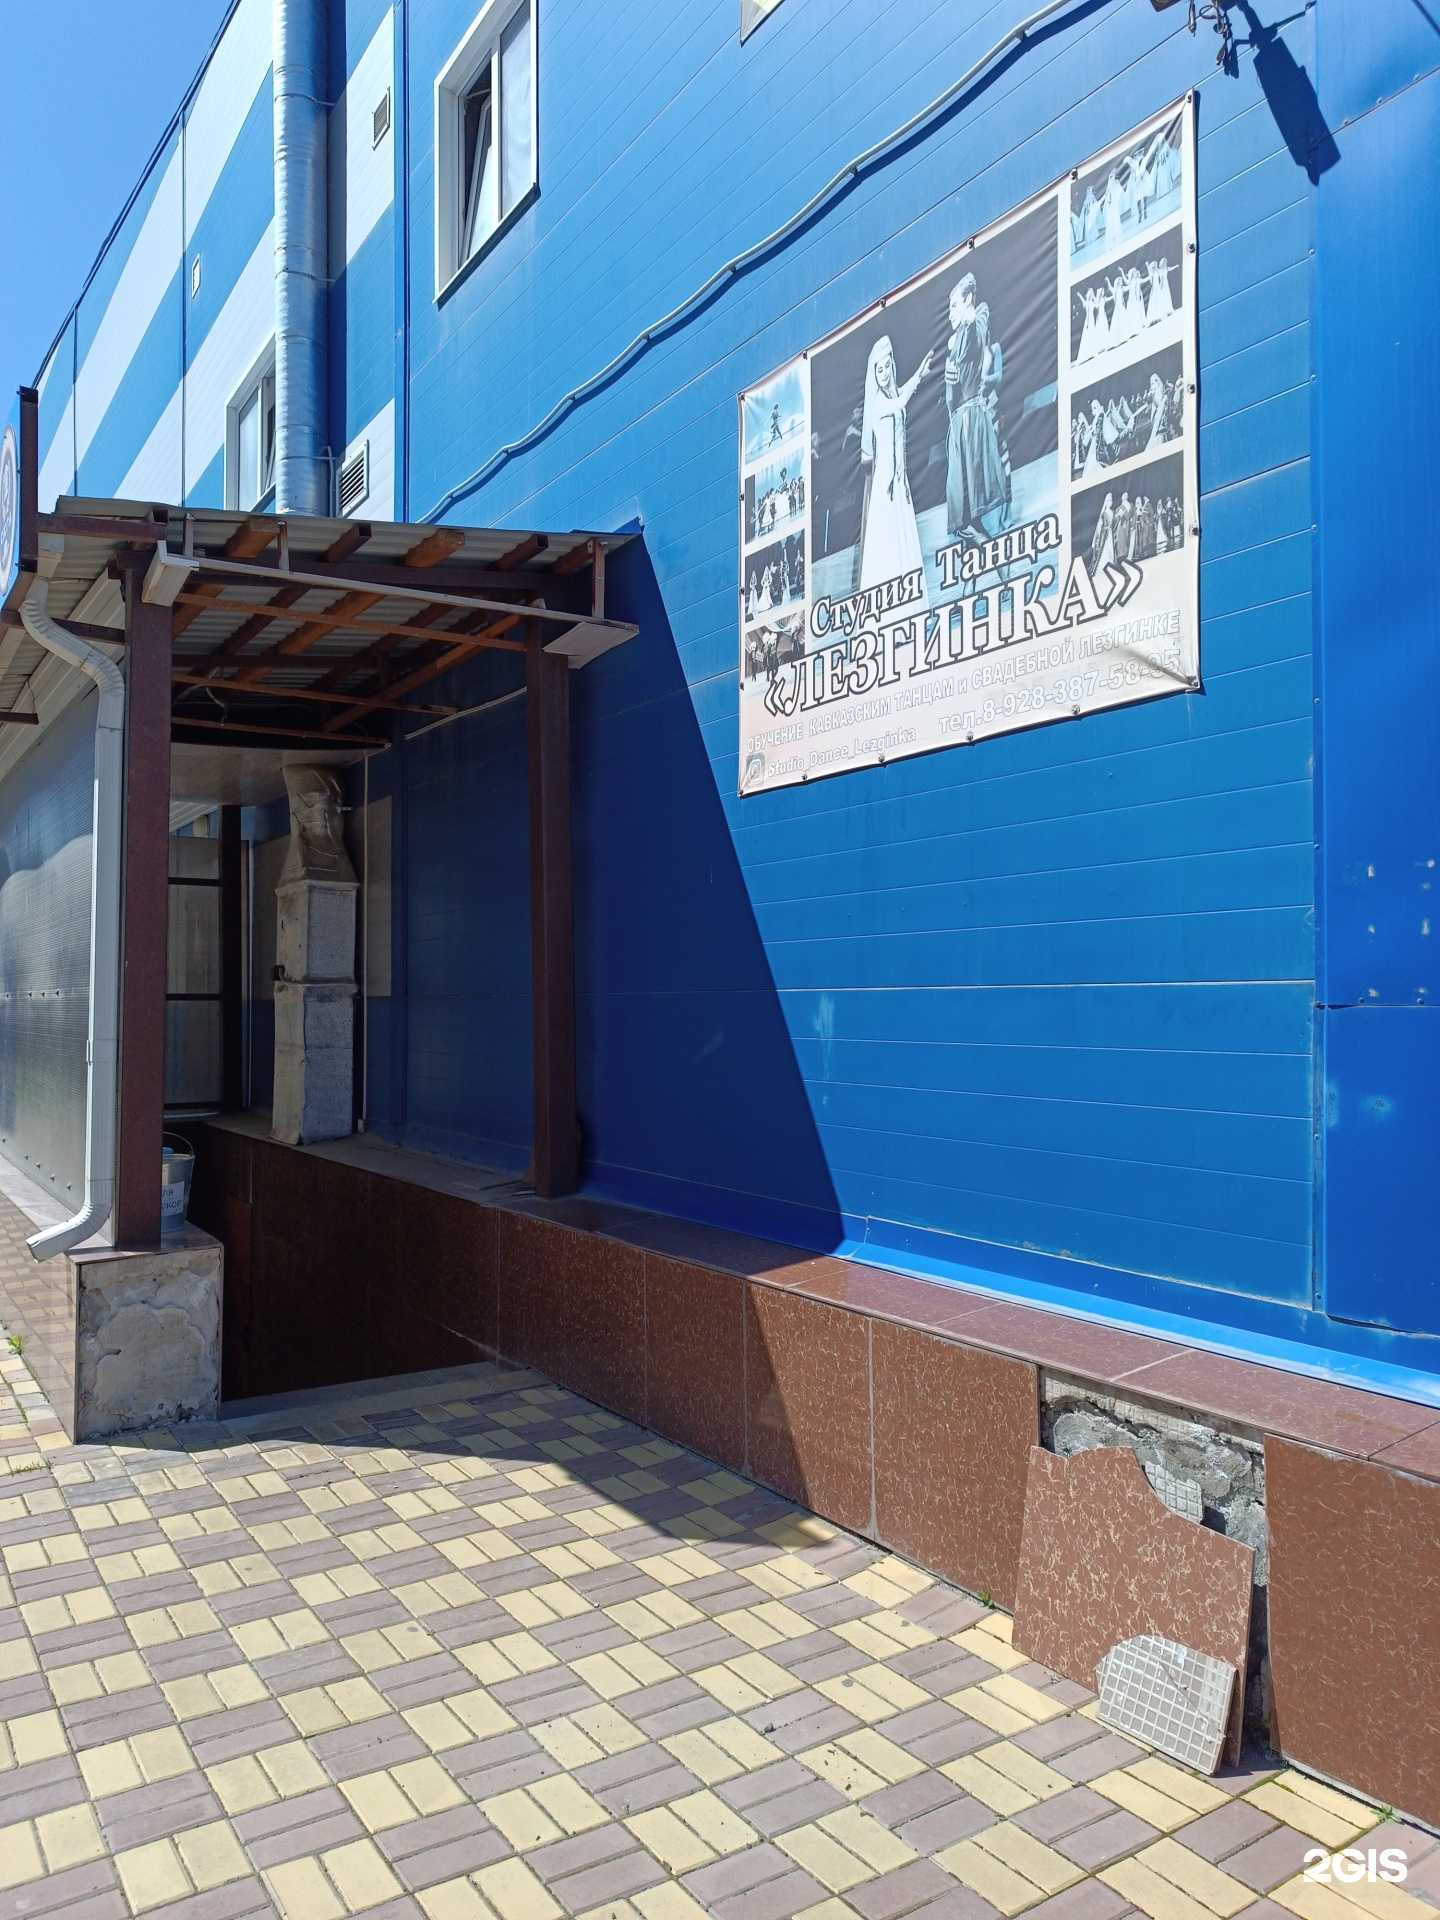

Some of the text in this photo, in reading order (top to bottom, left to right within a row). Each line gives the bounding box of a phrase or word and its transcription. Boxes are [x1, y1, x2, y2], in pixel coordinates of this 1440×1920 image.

[763, 556, 1144, 716] «ЛЕЗГИНКА»
[811, 513, 1062, 637] Студия Танца
[746, 722, 804, 752] ОБУЧЕНИЕ
[808, 698, 892, 736] КАВКАЗСКИМ
[895, 676, 955, 711] ТАНЦАМ
[971, 637, 1074, 690] СВАДЕБНОЙ
[1078, 609, 1181, 660] ЛЕЗГИНКЕ
